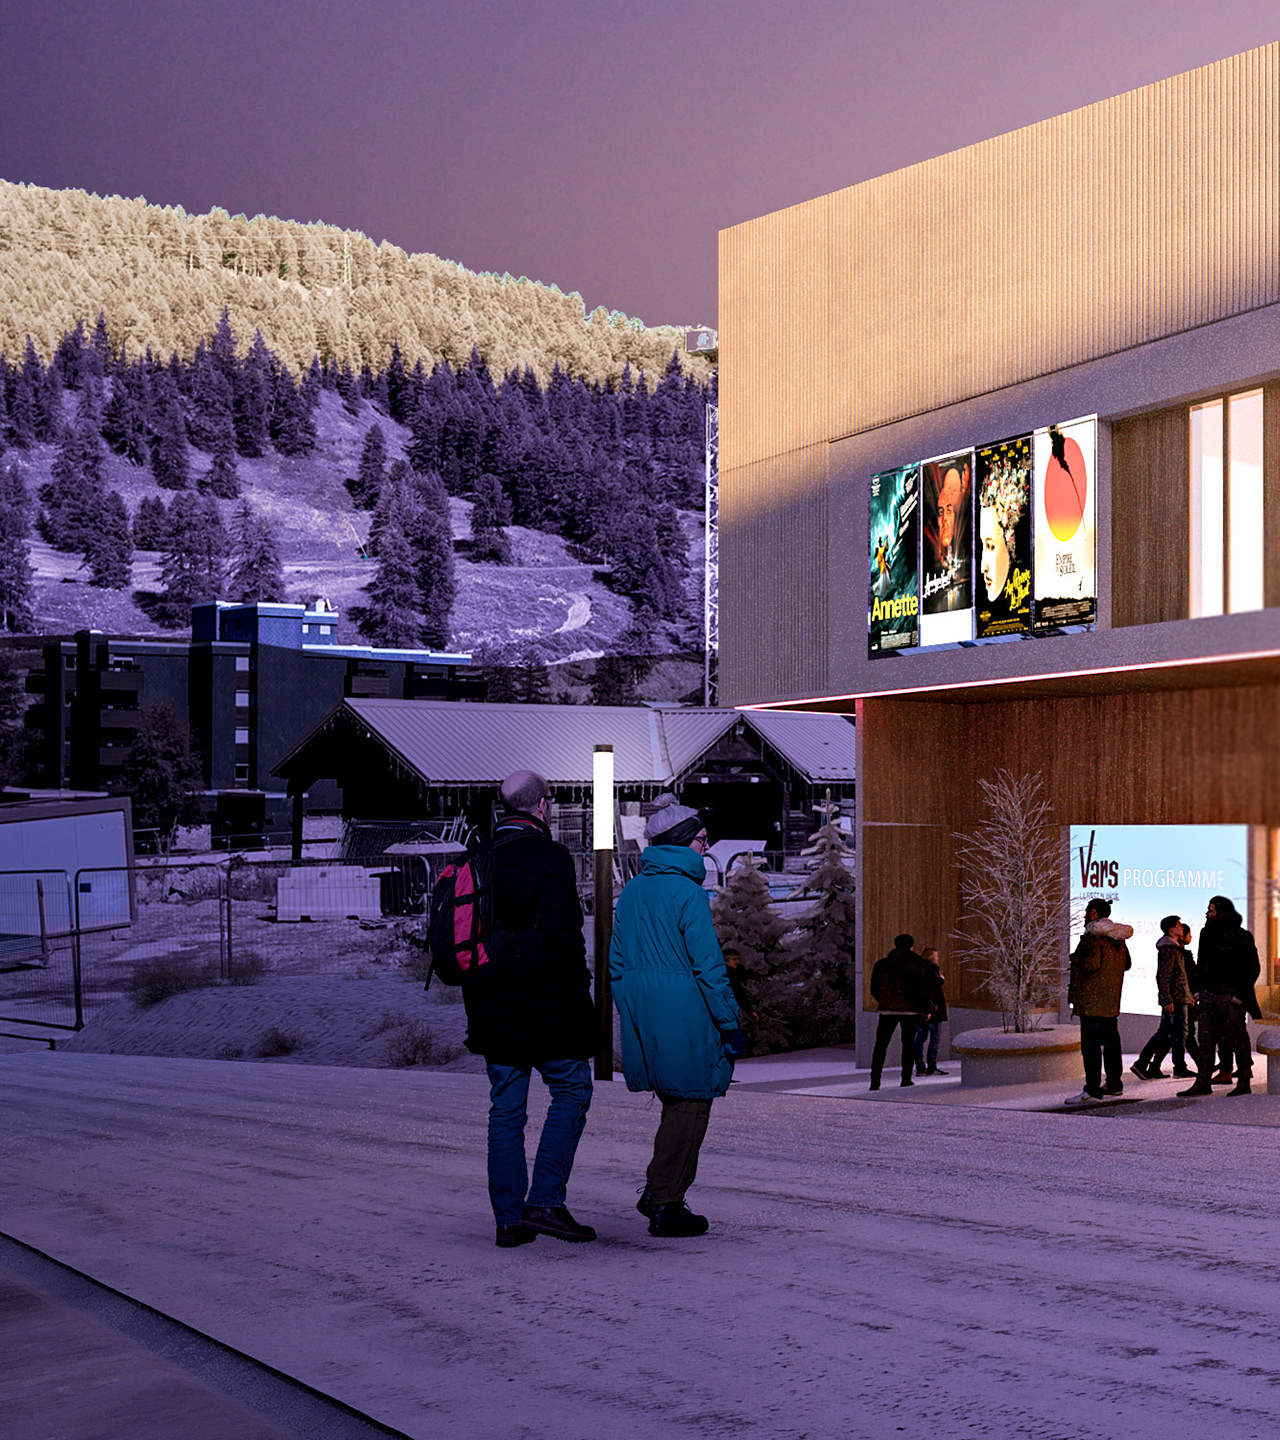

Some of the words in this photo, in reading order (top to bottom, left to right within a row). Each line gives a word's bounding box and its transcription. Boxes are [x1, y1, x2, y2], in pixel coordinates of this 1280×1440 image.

[871, 594, 918, 622] Annette
[1079, 829, 1119, 889] Vars
[1123, 868, 1227, 890] PROGRAMME
